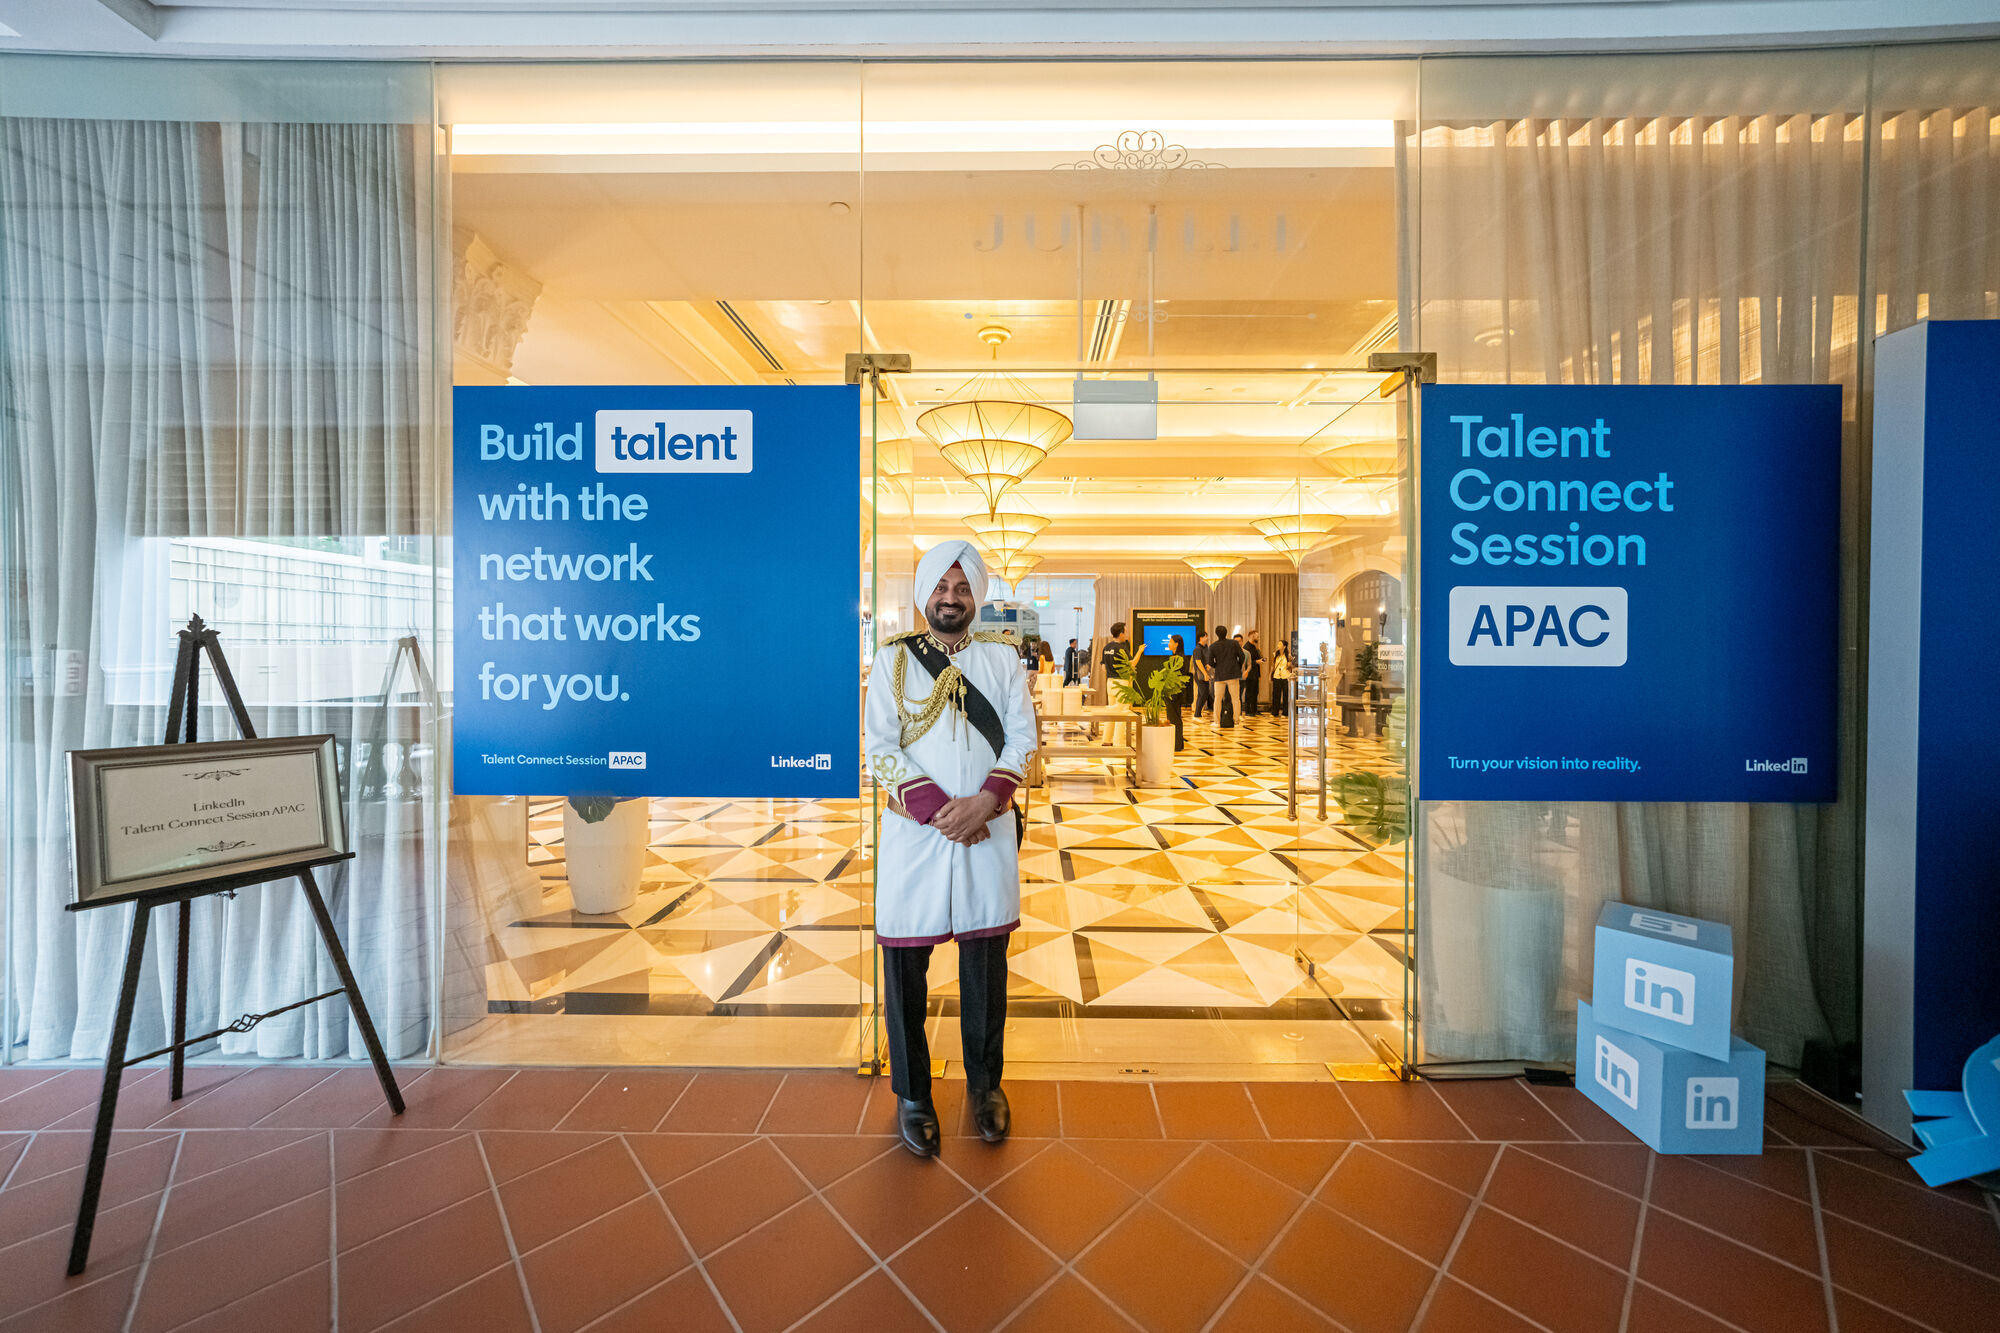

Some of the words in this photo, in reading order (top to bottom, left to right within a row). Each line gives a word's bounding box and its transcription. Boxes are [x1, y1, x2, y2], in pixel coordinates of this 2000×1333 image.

[481, 422, 583, 461] Build
[611, 422, 738, 461] talent
[1450, 413, 1610, 457] Talent
[478, 483, 569, 520] with
[578, 483, 648, 521] the
[1450, 469, 1673, 511] Connect
[480, 543, 653, 580] network
[1450, 522, 1646, 565] Session
[478, 602, 566, 640] that
[574, 603, 700, 641] works
[1467, 605, 1610, 647] APAC
[479, 662, 537, 700] for
[542, 674, 630, 710] you.
[481, 754, 515, 765] Talent
[517, 754, 564, 765] Connect
[566, 755, 607, 765] Session
[612, 755, 643, 766] APAC
[1448, 757, 1479, 769] Turn
[1482, 759, 1514, 772] your
[1516, 757, 1558, 769] vision
[1561, 757, 1589, 769] into
[1592, 757, 1641, 773] reality.
[121, 823, 165, 836] Talent
[168, 817, 224, 830] Connect
[226, 808, 270, 823] Session
[272, 803, 306, 816] APAC
[193, 798, 245, 812] LinkedIn
[1634, 967, 1685, 1016] in
[1601, 1044, 1632, 1099] in
[1693, 1084, 1731, 1122] in
